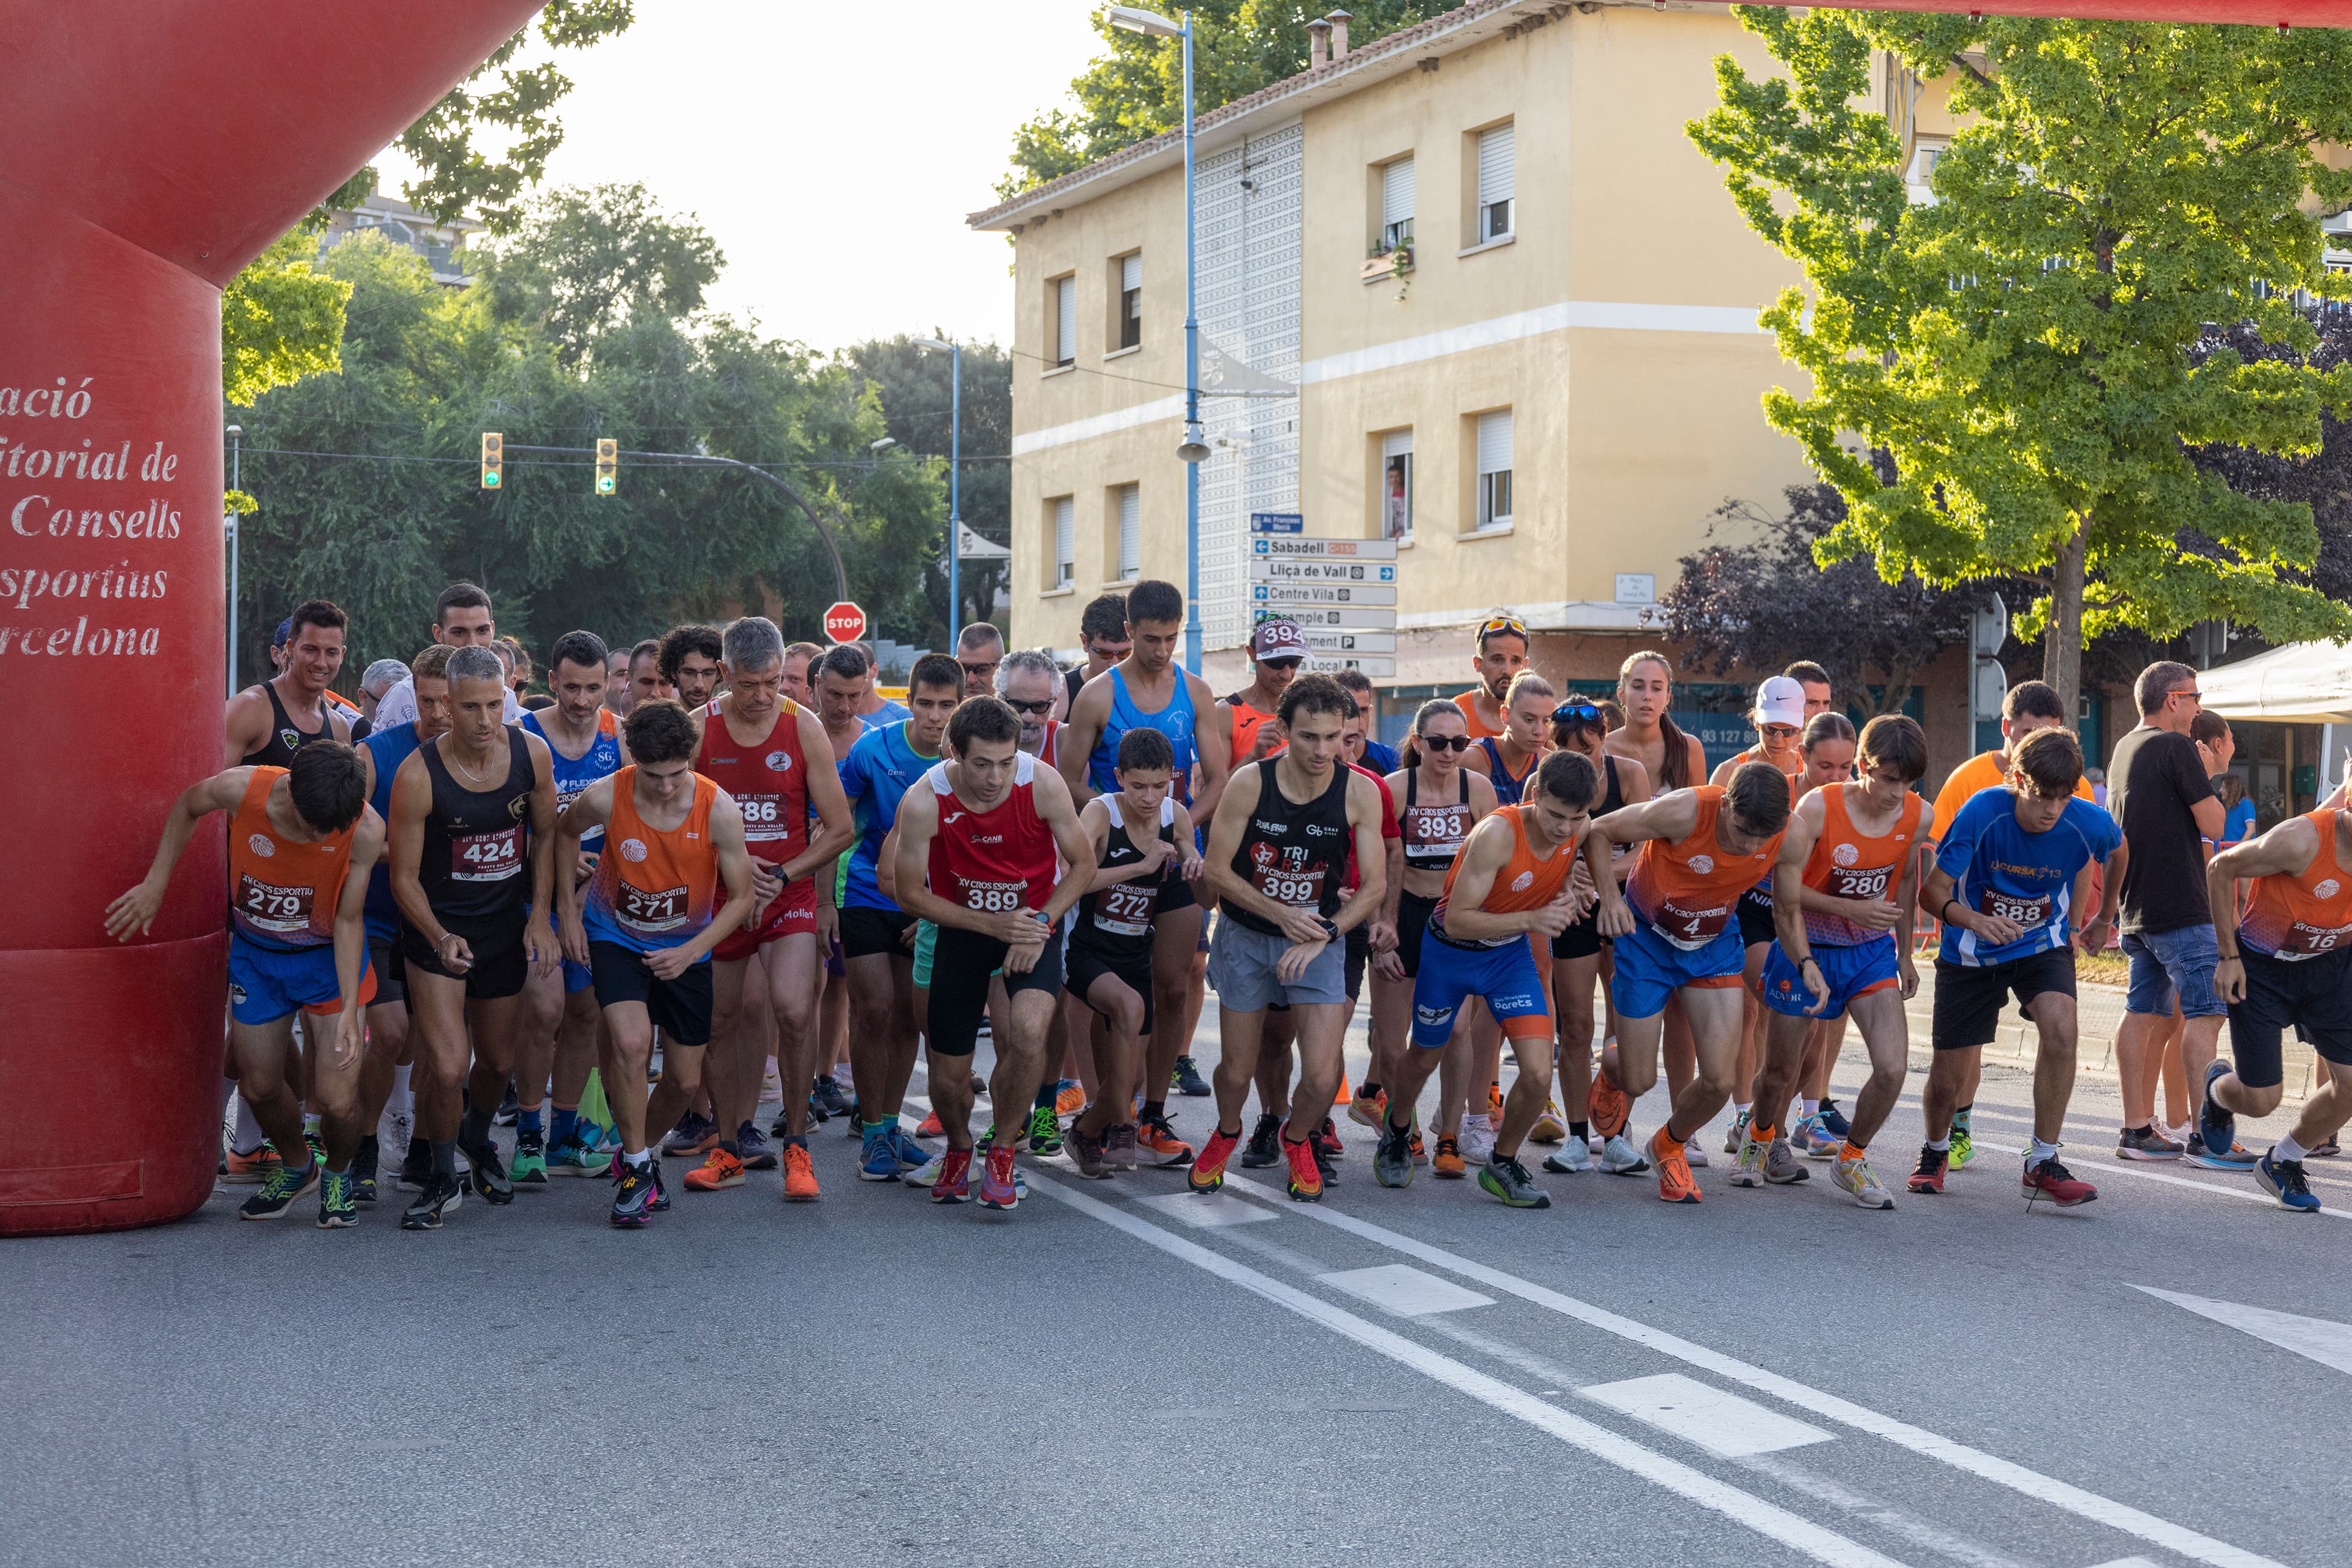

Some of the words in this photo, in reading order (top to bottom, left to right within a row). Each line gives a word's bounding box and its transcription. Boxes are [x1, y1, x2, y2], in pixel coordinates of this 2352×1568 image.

[141, 441, 178, 482] de
[11, 495, 181, 539] Consells
[1272, 541, 1324, 554] Sabadell
[1270, 564, 1300, 579] Lliçà
[1305, 565, 1319, 576] de
[1324, 566, 1346, 577] Vall
[1270, 587, 1309, 599] Centre
[1312, 589, 1334, 600] Vila
[828, 617, 861, 629] STOP
[1264, 625, 1305, 644] 394
[1312, 660, 1342, 671] Local
[1702, 729, 1716, 743] 93
[1720, 729, 1740, 743] 127
[1743, 729, 1757, 743] 89
[598, 752, 612, 762] SG
[1437, 805, 1469, 816] ESPORTIU
[1418, 815, 1462, 837] 393
[463, 838, 515, 862] 424
[1283, 846, 1309, 861] TRI
[1257, 864, 1268, 873] XV
[1269, 868, 1289, 880] CROS
[1290, 871, 1325, 881] ESPORTIU
[253, 879, 273, 894] CROS
[273, 888, 313, 896] ESPORTIU
[621, 881, 630, 891] XV
[630, 889, 650, 900] CROS
[650, 887, 687, 900] ESPORTIU
[959, 878, 970, 887] XV
[971, 881, 992, 889] CROS
[993, 879, 1028, 891] ESPORTIU
[1116, 884, 1134, 894] CROS
[1262, 877, 1313, 900] 399
[1839, 875, 1887, 894] 280
[248, 888, 300, 916] 279
[627, 894, 673, 917] 271
[968, 889, 1018, 911] 389
[1106, 892, 1148, 917] 272
[1749, 891, 1774, 907] NIK
[1986, 889, 1996, 899] XV
[1997, 894, 2017, 905] CROS
[2017, 894, 2050, 907] ESPORTIU
[784, 908, 813, 920] Mollet
[1664, 902, 1676, 912] XV
[1675, 909, 1695, 918] CROS
[1695, 907, 1727, 918] ESPORTIU
[1992, 902, 2041, 921] 388
[1683, 918, 1700, 935] 4
[2308, 935, 2337, 948] 16
[1494, 999, 1532, 1009] Parets
